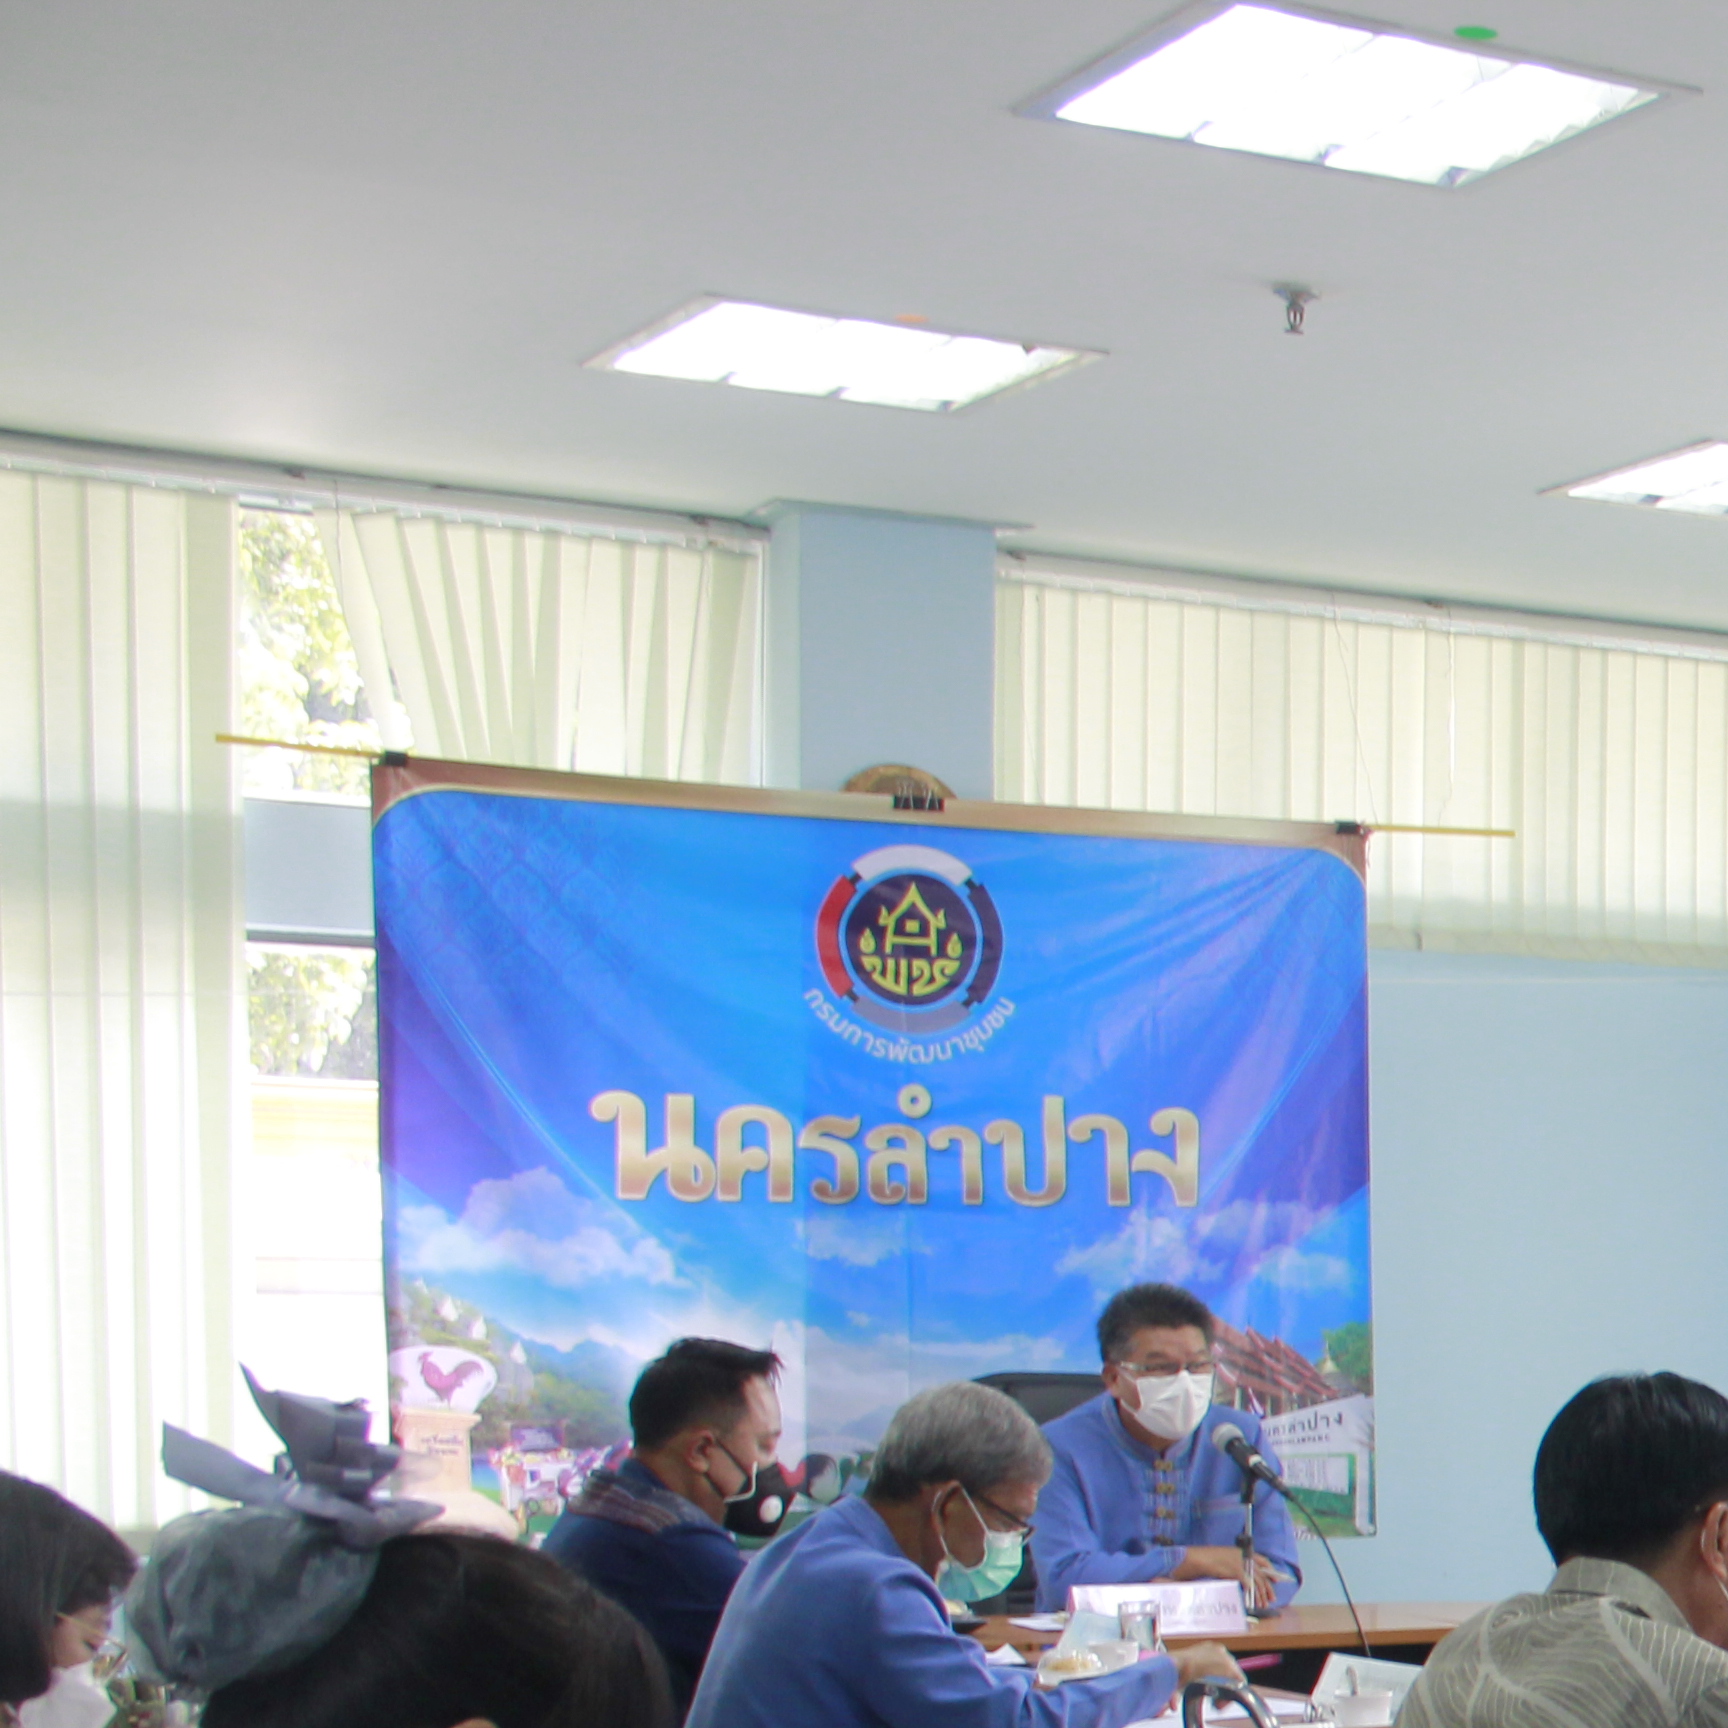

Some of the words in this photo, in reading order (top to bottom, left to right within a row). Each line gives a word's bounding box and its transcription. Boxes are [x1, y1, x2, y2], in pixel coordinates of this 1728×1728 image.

[804, 988, 1016, 1064] กรมการพัฒนาชุมชน
[591, 1083, 1200, 1207] นครลำปาง
